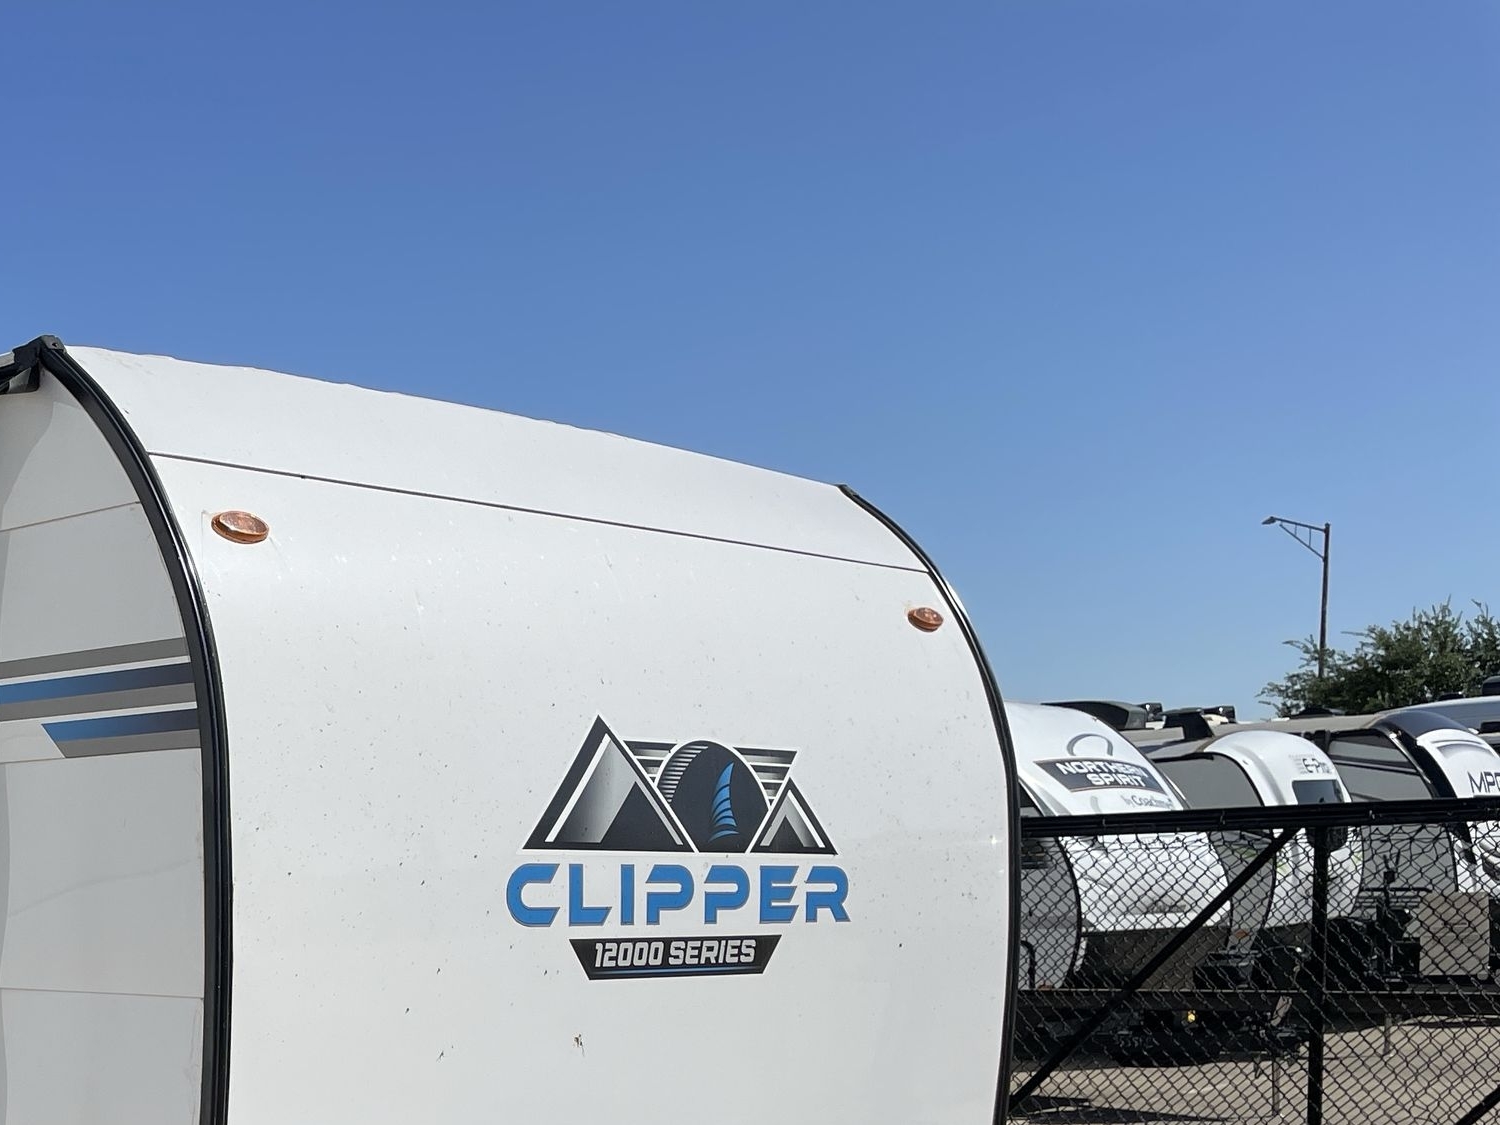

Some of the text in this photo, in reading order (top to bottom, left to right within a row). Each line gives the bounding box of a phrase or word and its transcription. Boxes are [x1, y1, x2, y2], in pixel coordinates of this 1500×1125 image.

[1055, 761, 1149, 778] NORTHERN
[1086, 773, 1147, 787] SPIRIT
[505, 862, 852, 928] CLIPPER
[595, 938, 757, 968] 12000 SERIES
